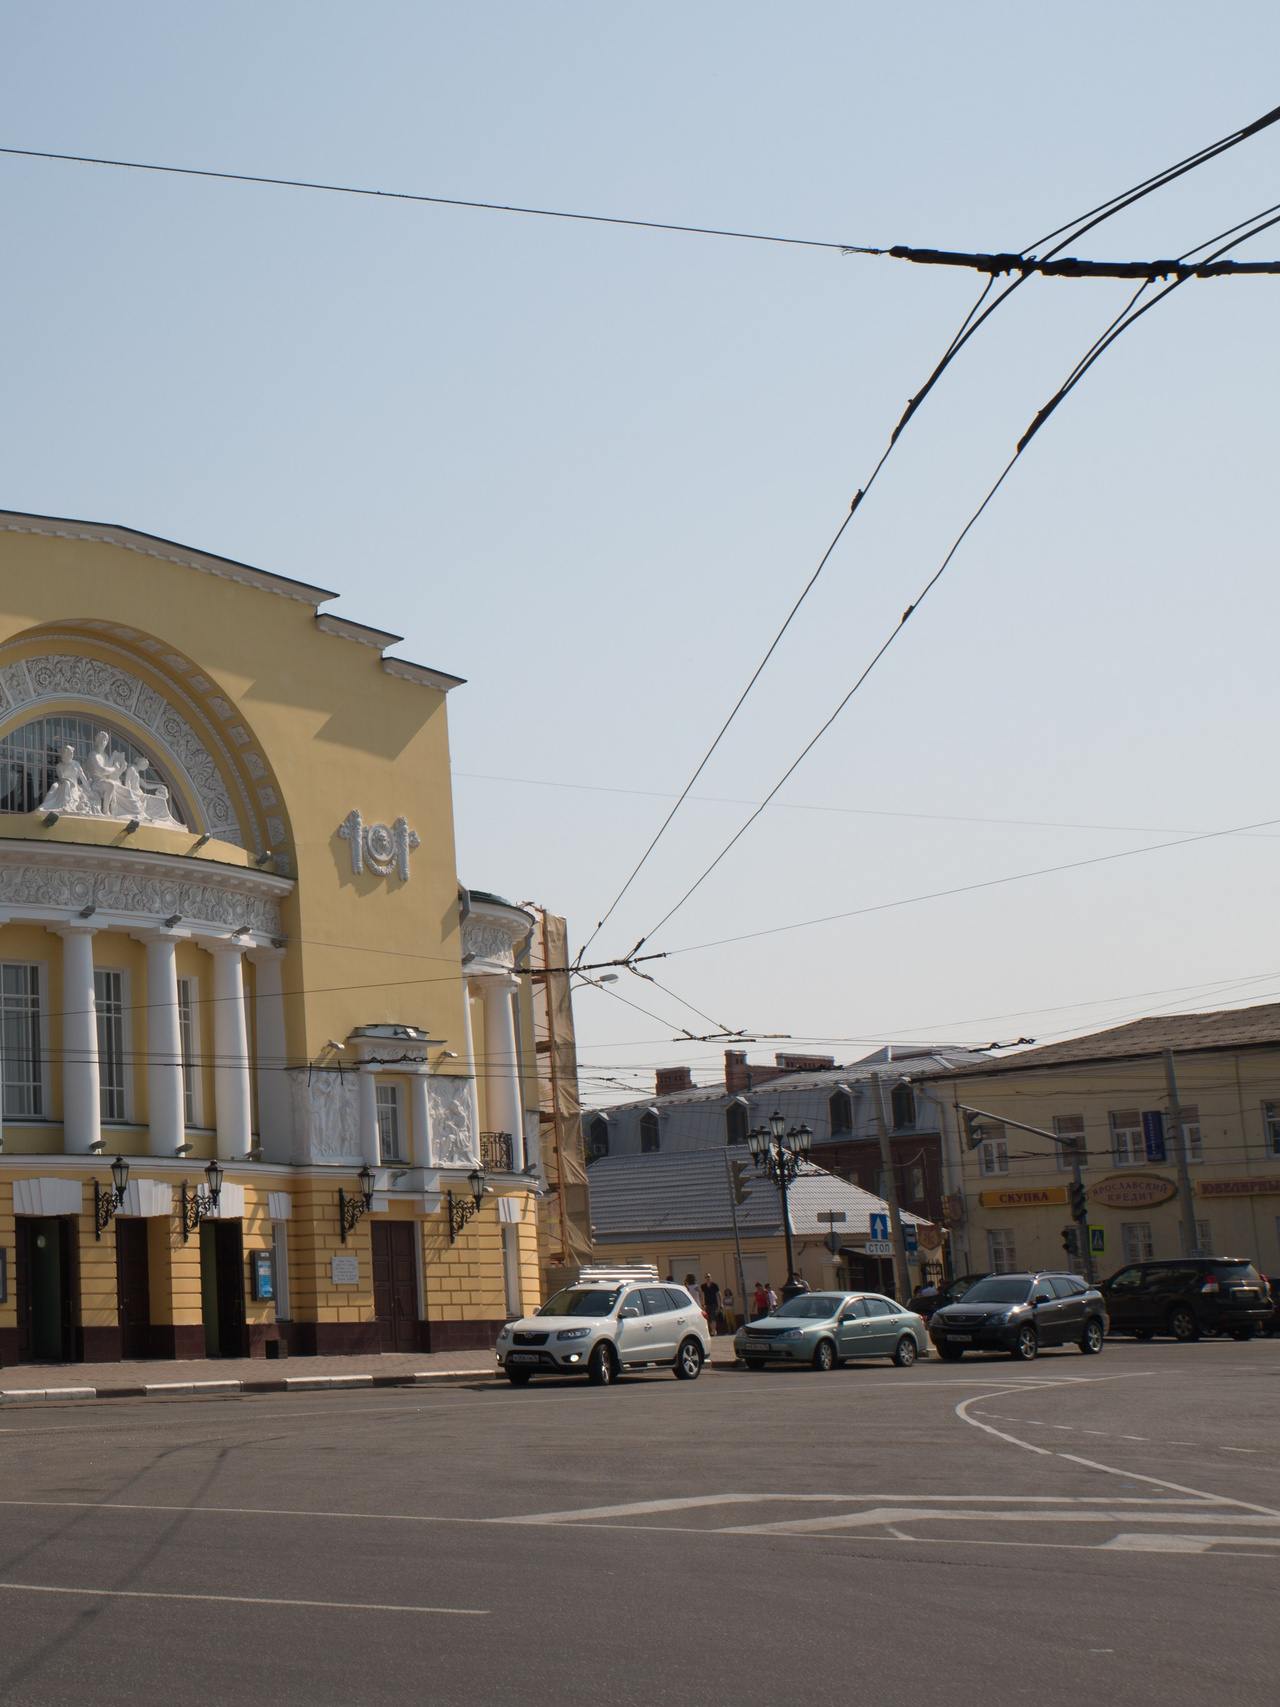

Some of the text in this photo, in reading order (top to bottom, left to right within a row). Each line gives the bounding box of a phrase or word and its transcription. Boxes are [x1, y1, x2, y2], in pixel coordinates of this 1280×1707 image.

[1092, 1181, 1168, 1197] ЯРОСЛАВСКИЙ
[999, 1191, 1048, 1203] СКУПКА
[1107, 1192, 1154, 1202] КРЕДИТ
[868, 1243, 891, 1253] СТОП
